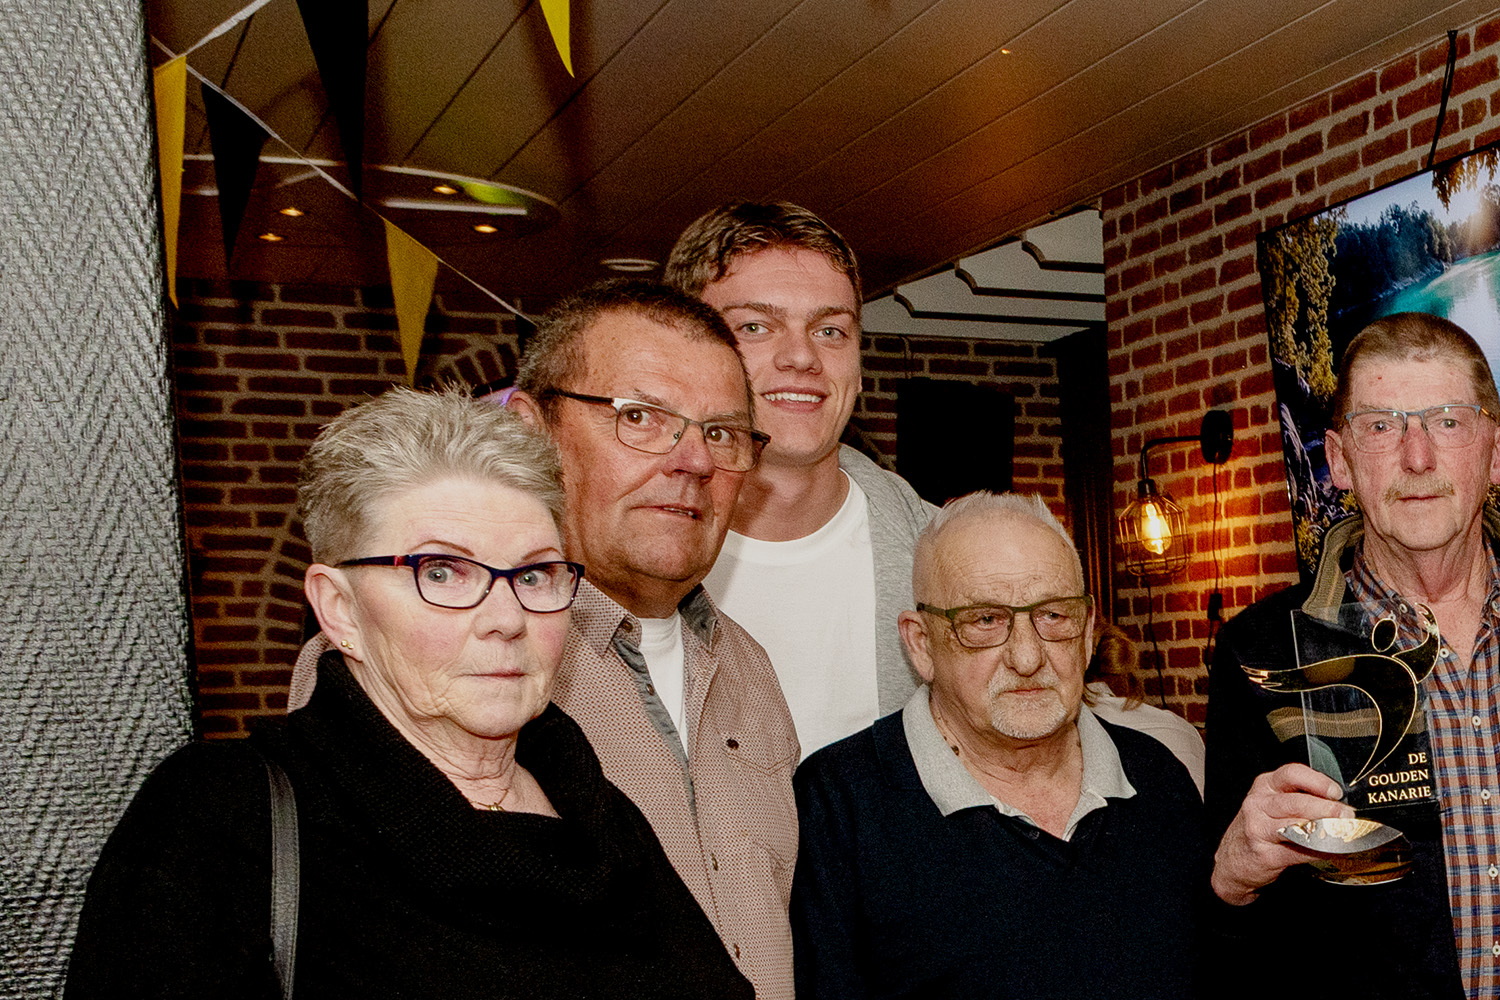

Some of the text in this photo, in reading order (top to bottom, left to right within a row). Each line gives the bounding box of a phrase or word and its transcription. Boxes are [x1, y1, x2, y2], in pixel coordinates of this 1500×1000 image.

[1408, 752, 1427, 764] DE
[1368, 769, 1429, 787] GOUDEN
[1367, 785, 1431, 804] KANARIE
